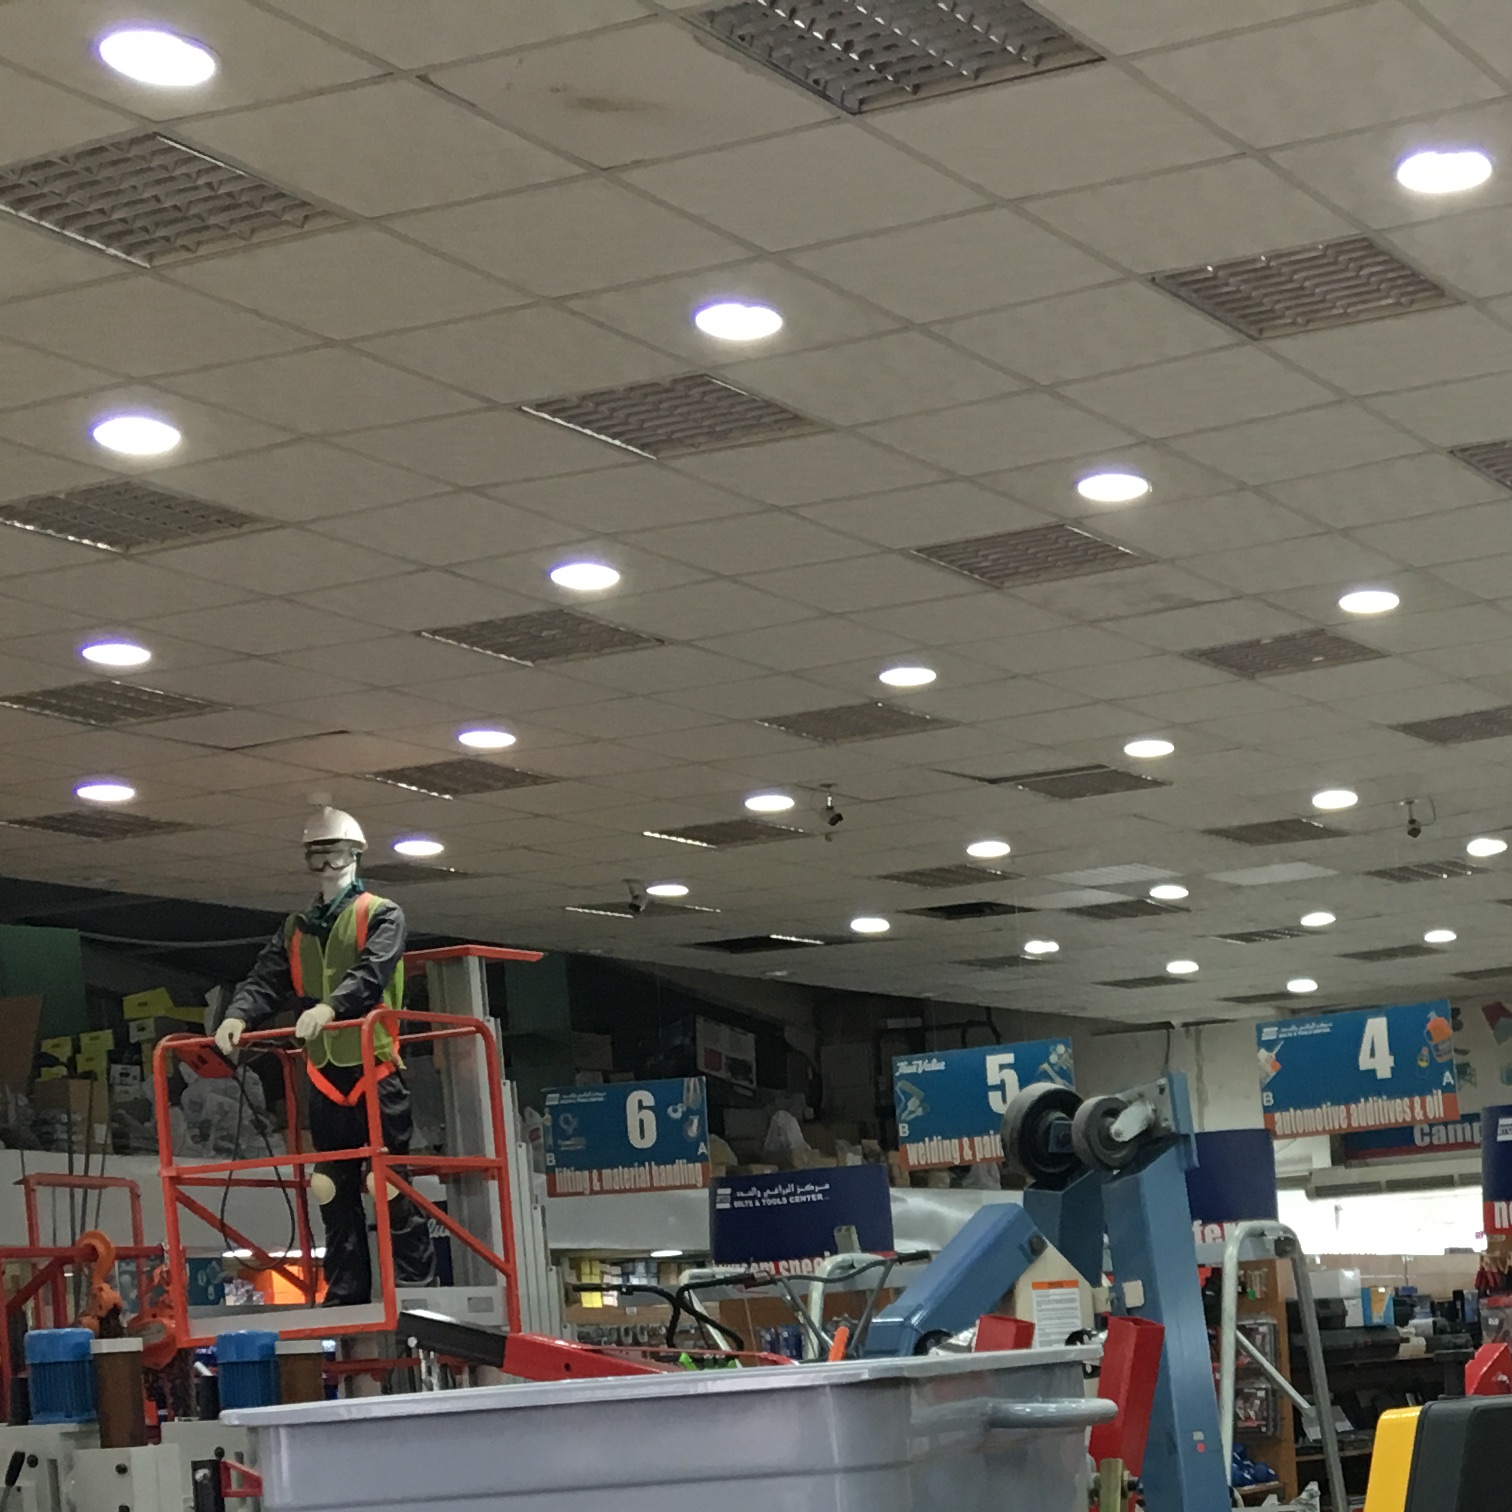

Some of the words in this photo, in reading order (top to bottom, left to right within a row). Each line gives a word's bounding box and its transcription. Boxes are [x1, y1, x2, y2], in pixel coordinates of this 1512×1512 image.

[1359, 1016, 1395, 1080] 4
[985, 1053, 1020, 1114] 5
[1443, 1071, 1454, 1086] A
[1263, 1092, 1274, 1106] B
[1275, 1102, 1348, 1136] automotive
[1350, 1096, 1411, 1128] additives
[1414, 1095, 1424, 1121] &
[1426, 1089, 1444, 1120] oil
[626, 1090, 657, 1149] 6
[899, 1123, 910, 1137] B
[546, 1153, 556, 1166] B
[698, 1142, 708, 1155] A
[906, 1135, 961, 1166] welding
[962, 1137, 973, 1161] &
[555, 1167, 590, 1194] lifting
[602, 1161, 650, 1190] material
[651, 1159, 703, 1188] handling
